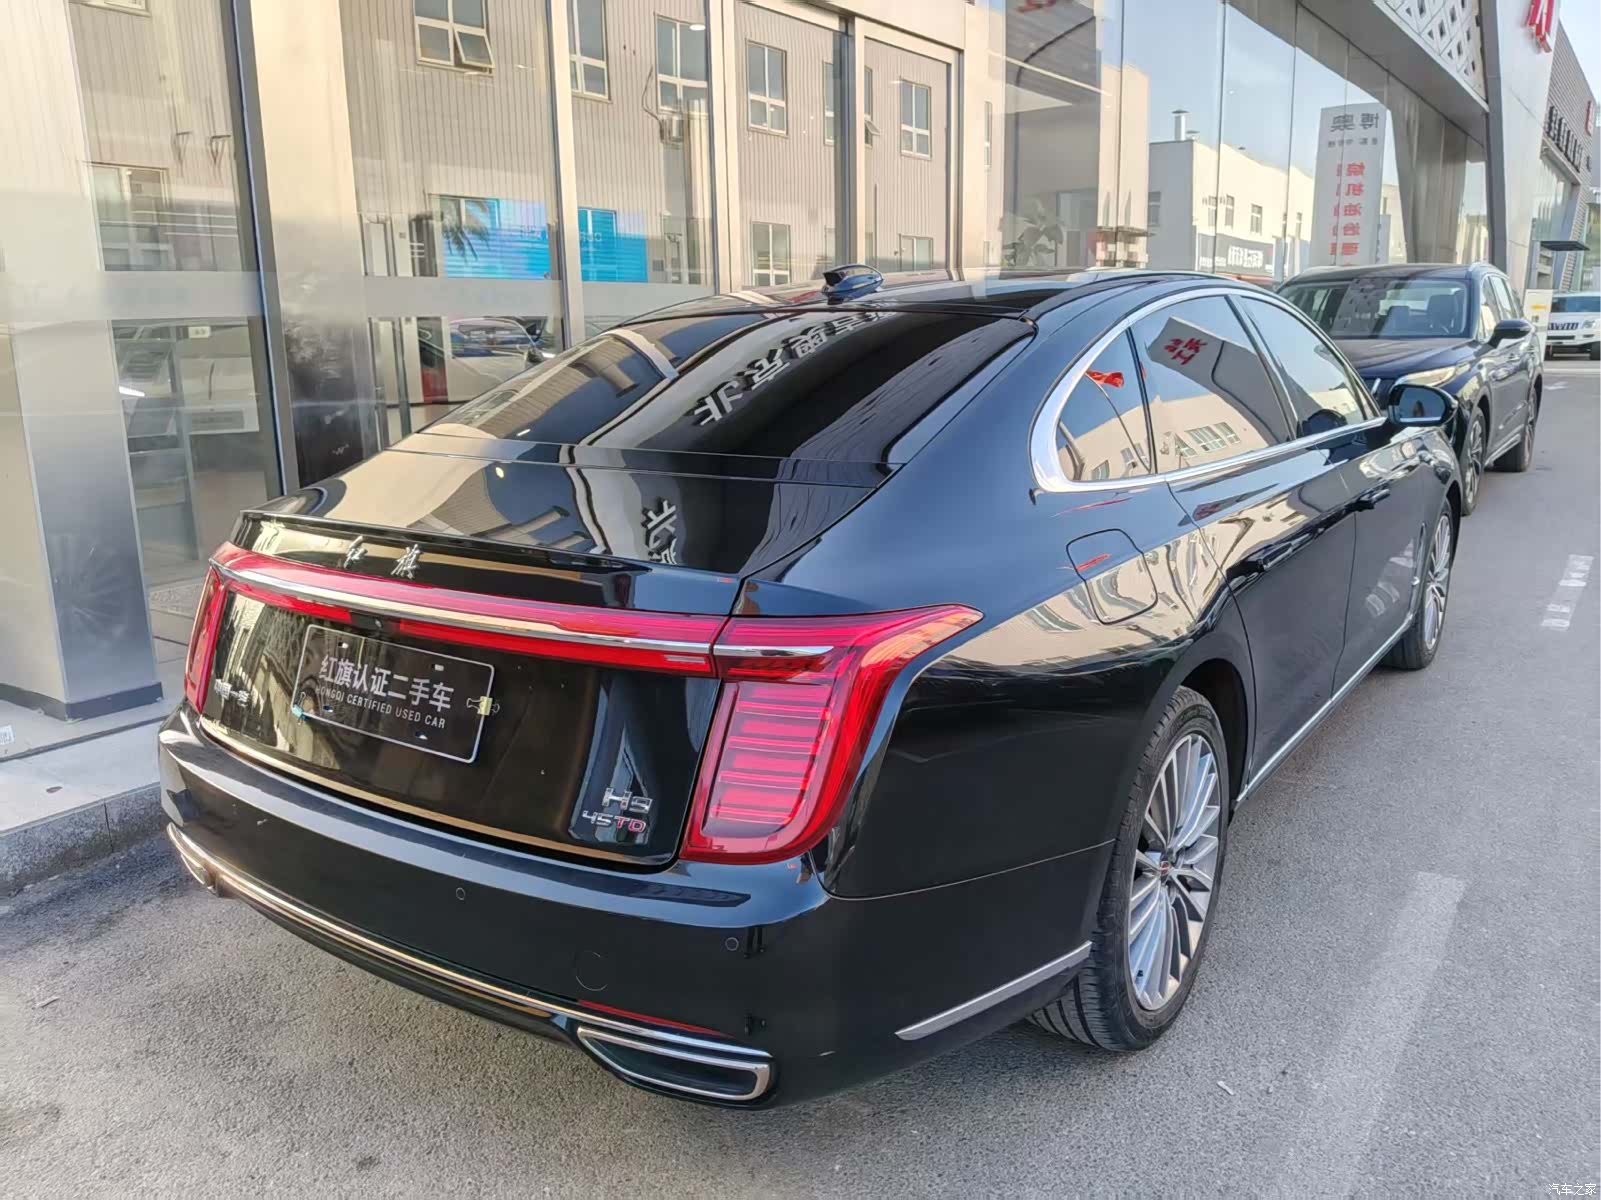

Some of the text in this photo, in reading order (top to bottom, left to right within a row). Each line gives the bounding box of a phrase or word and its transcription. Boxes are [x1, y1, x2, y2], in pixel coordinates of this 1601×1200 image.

[343, 535, 420, 579] 红旗
[319, 655, 454, 712] 红旗认证二手车
[316, 687, 446, 729] HONGQI CERTIFIED USED CAR
[582, 810, 646, 832] 45TD
